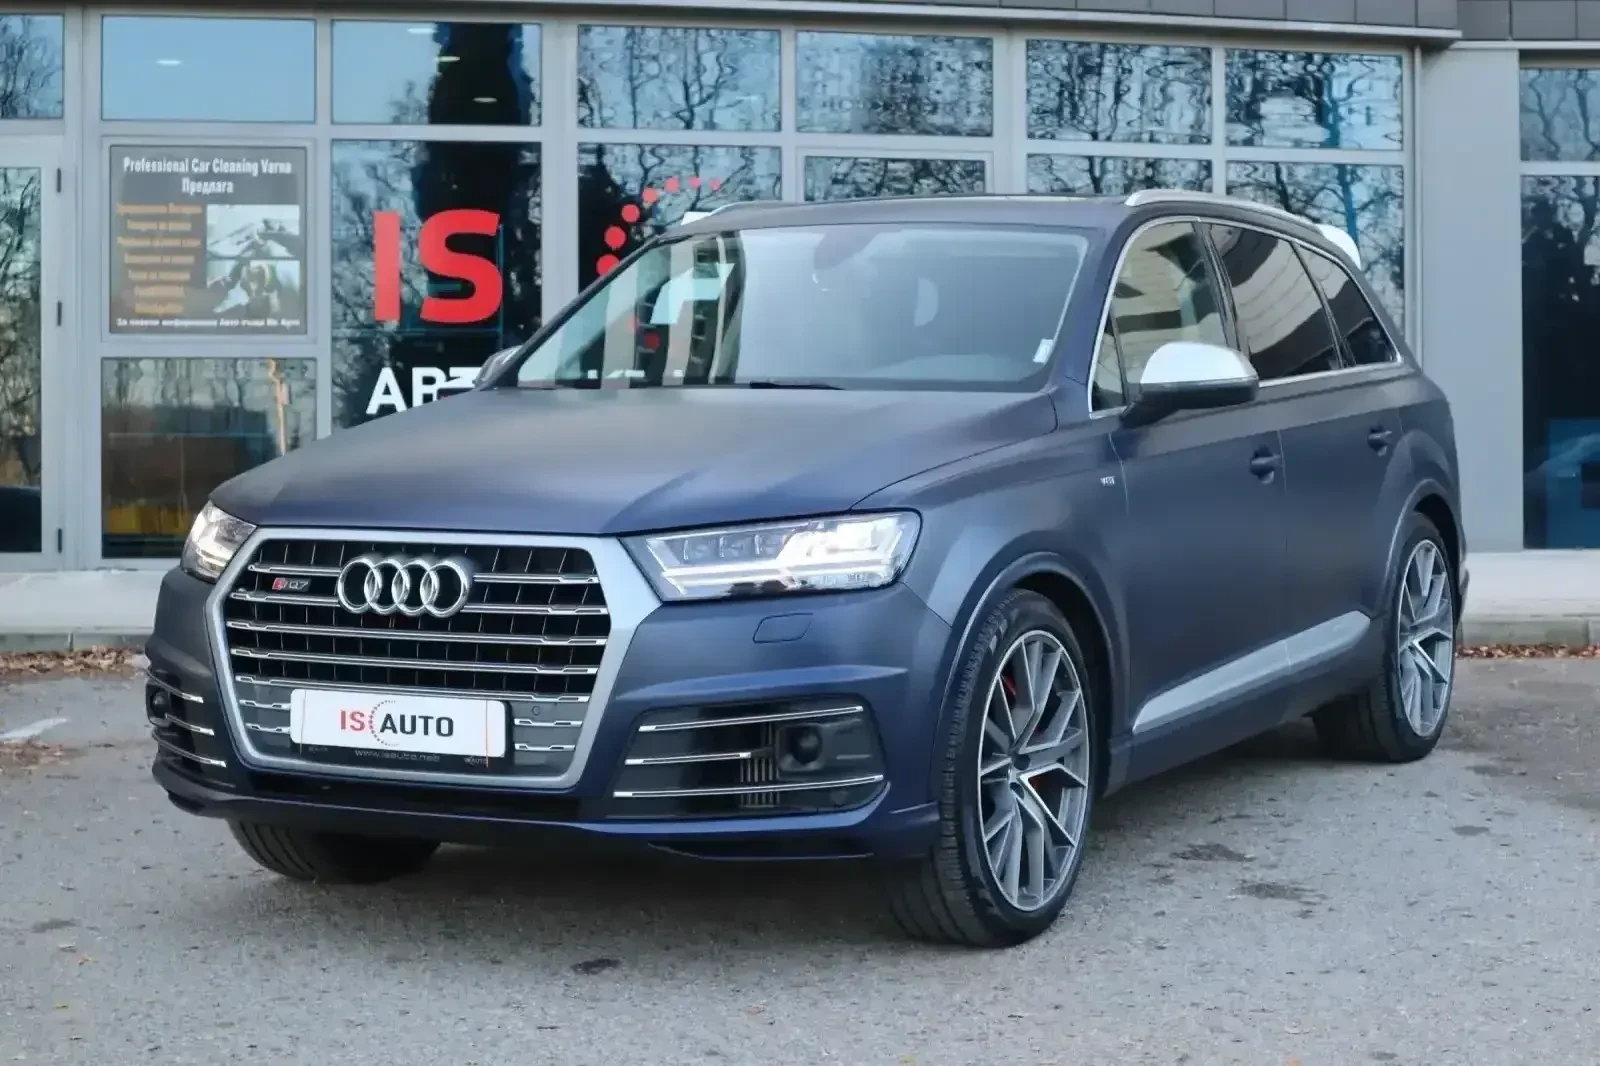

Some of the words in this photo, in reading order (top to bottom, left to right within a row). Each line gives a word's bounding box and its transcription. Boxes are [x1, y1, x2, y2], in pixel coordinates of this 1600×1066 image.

[123, 156, 189, 173] Professional
[191, 158, 211, 174] Car
[212, 158, 258, 177] Cleaning
[260, 159, 292, 174] Varna
[181, 177, 234, 196] Предлага
[372, 208, 503, 324] IS
[340, 710, 366, 732] IS
[380, 713, 454, 738] AUTO
